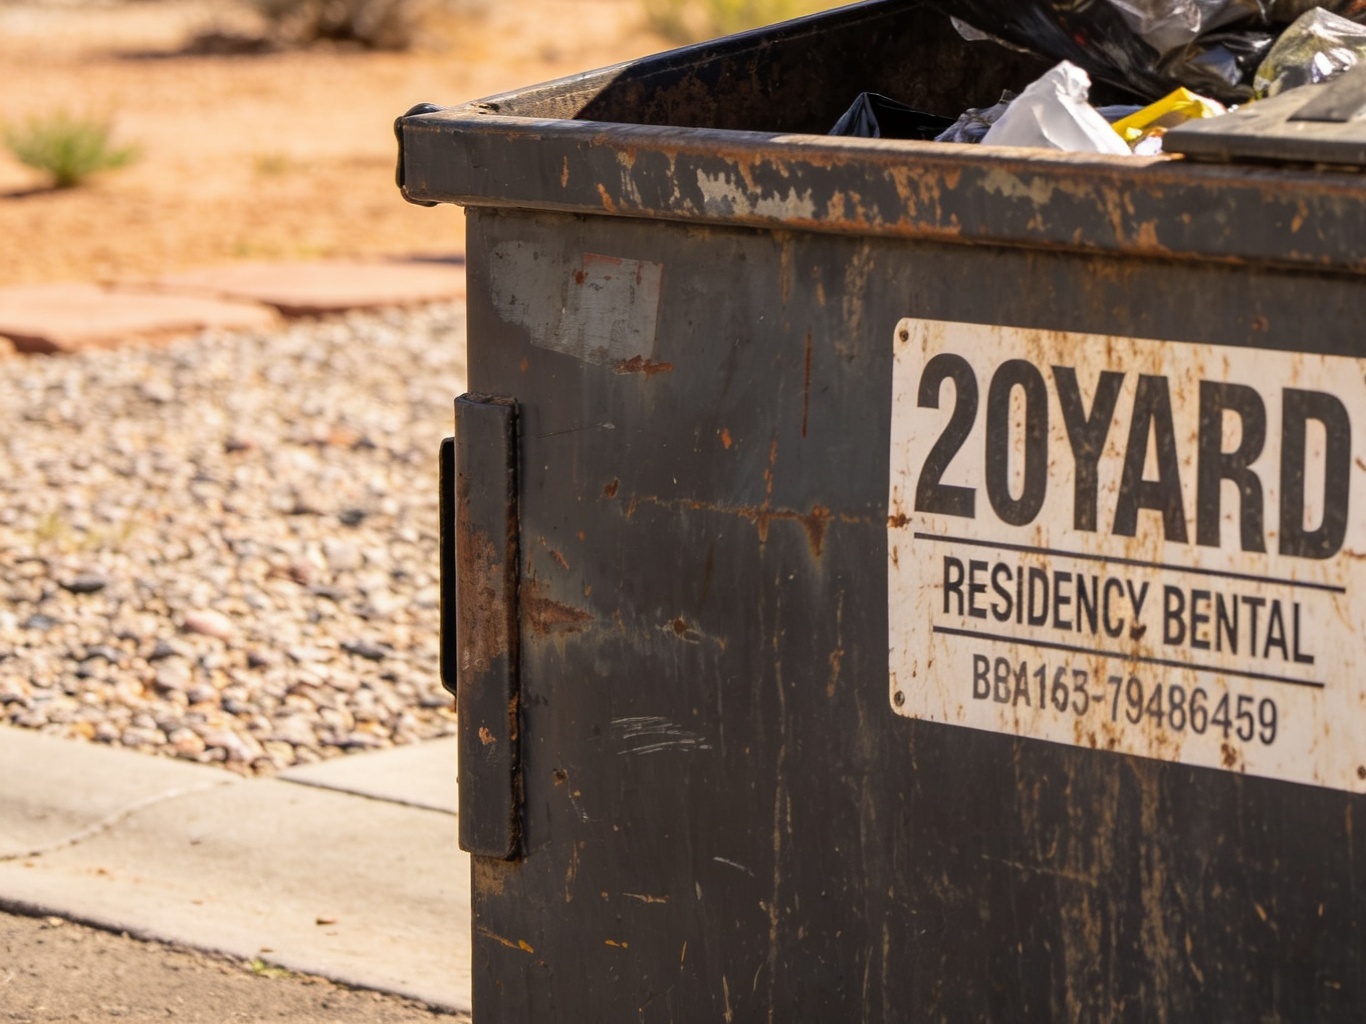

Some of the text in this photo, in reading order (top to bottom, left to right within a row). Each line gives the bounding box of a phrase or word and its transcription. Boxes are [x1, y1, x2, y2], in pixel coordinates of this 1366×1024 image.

[914, 353, 1351, 559] 20YARD
[943, 556, 1315, 664] RESIDENCY BENTAL
